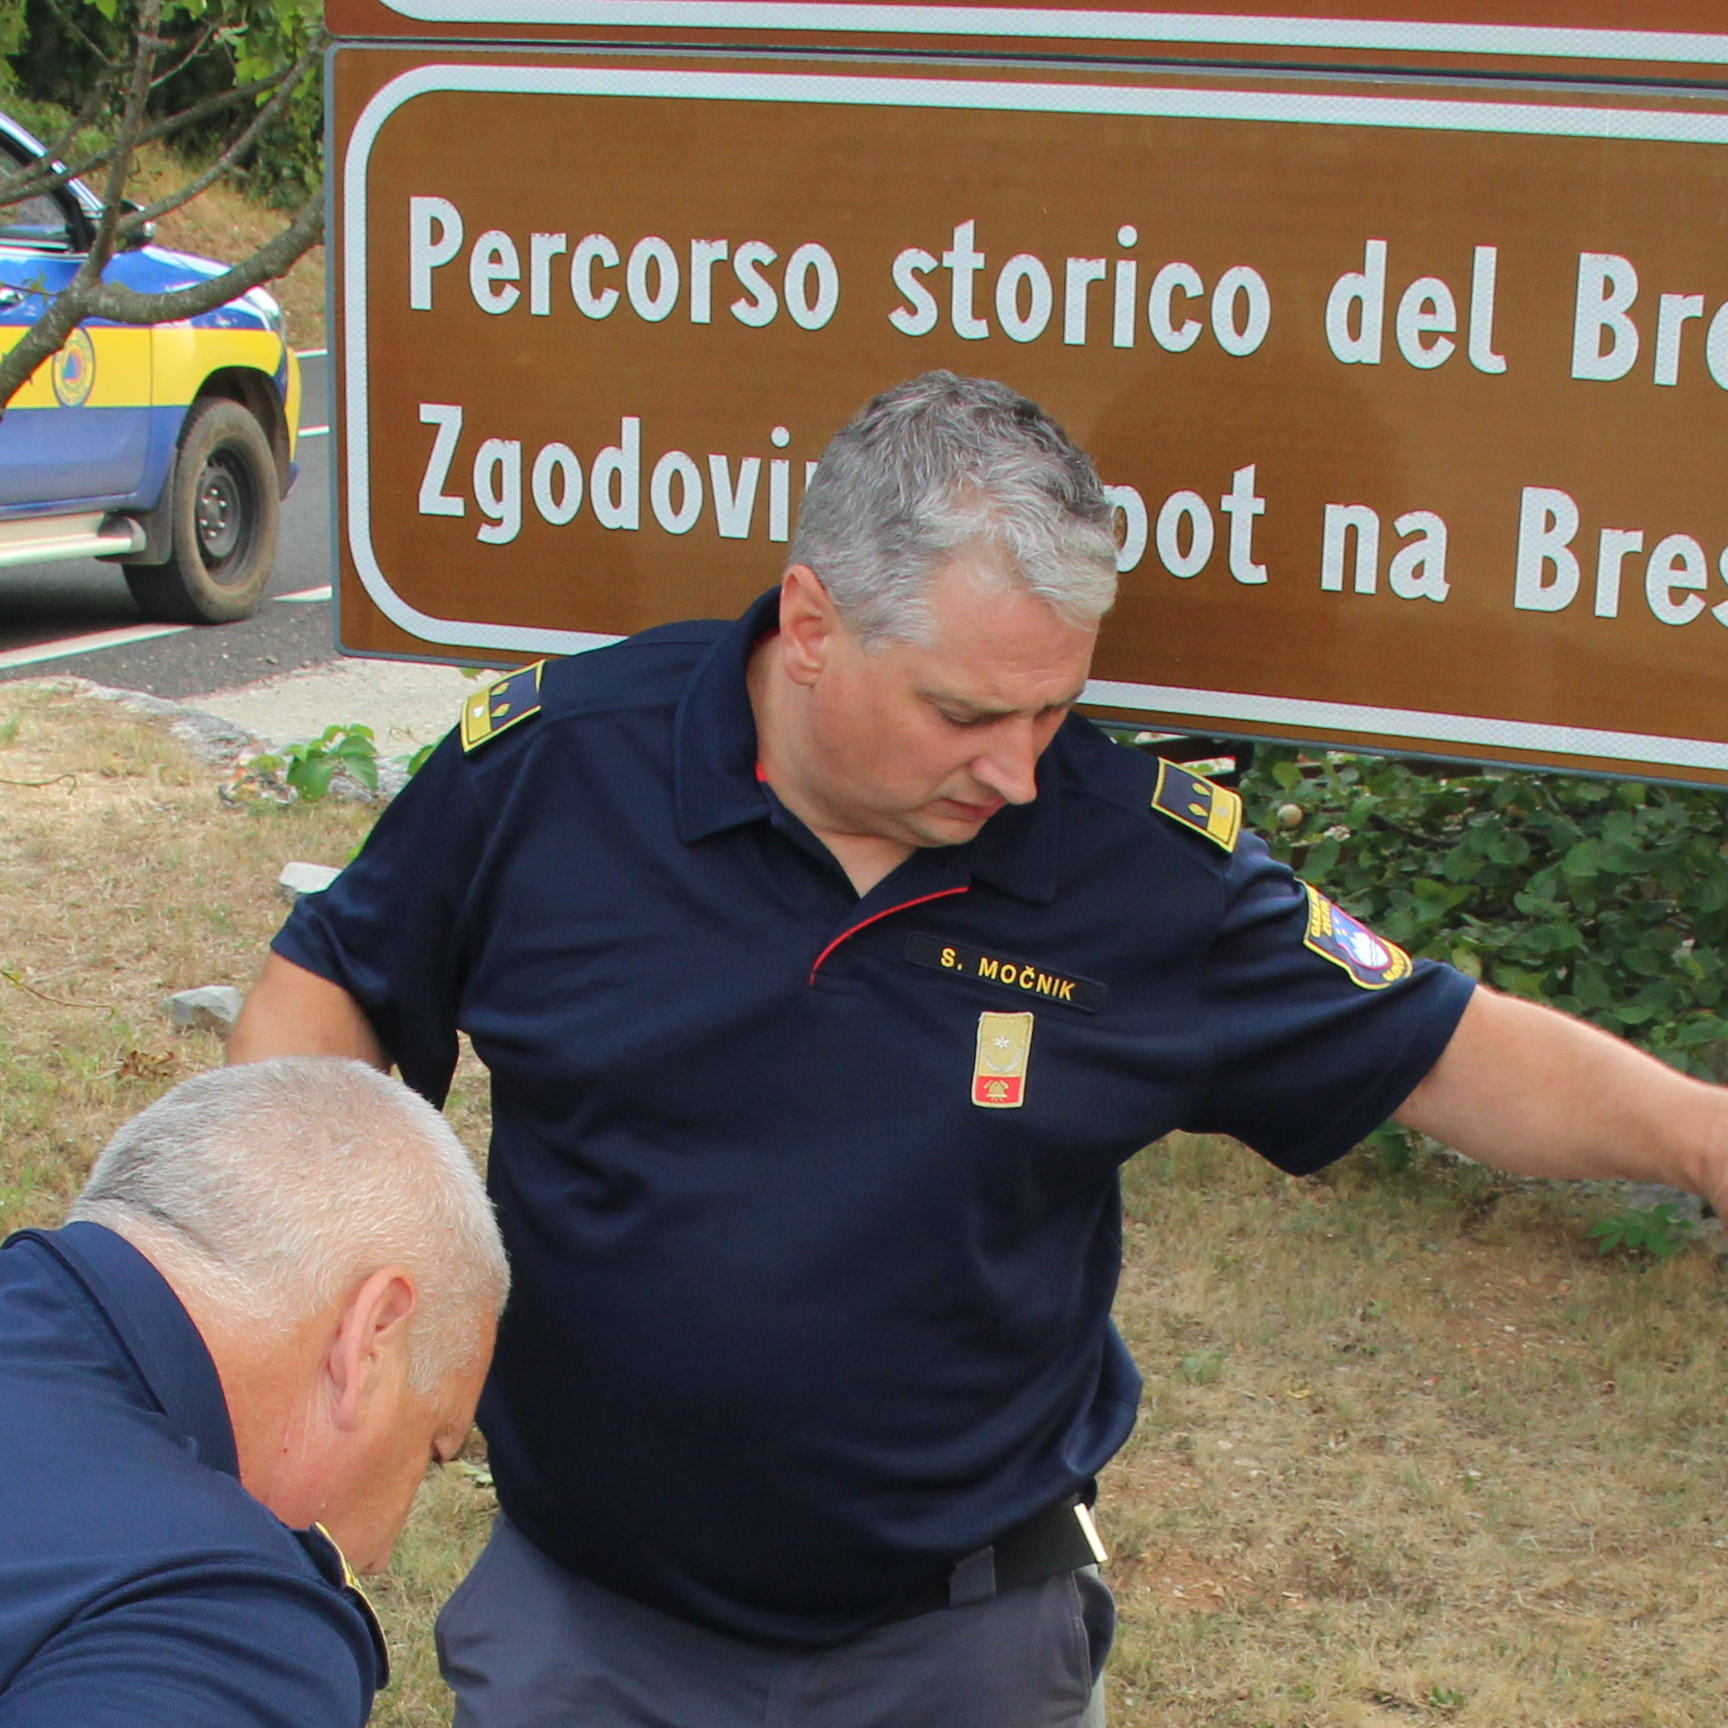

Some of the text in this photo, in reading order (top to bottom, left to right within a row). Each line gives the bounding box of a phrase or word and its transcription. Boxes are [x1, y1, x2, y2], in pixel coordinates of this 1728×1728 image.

[408, 195, 840, 331] Percorso
[887, 218, 1272, 357] storico
[1324, 238, 1508, 375] del
[417, 402, 818, 546] Zgodovi
[1320, 502, 1452, 603] na
[940, 947, 1076, 1000] S. MOČNIK
